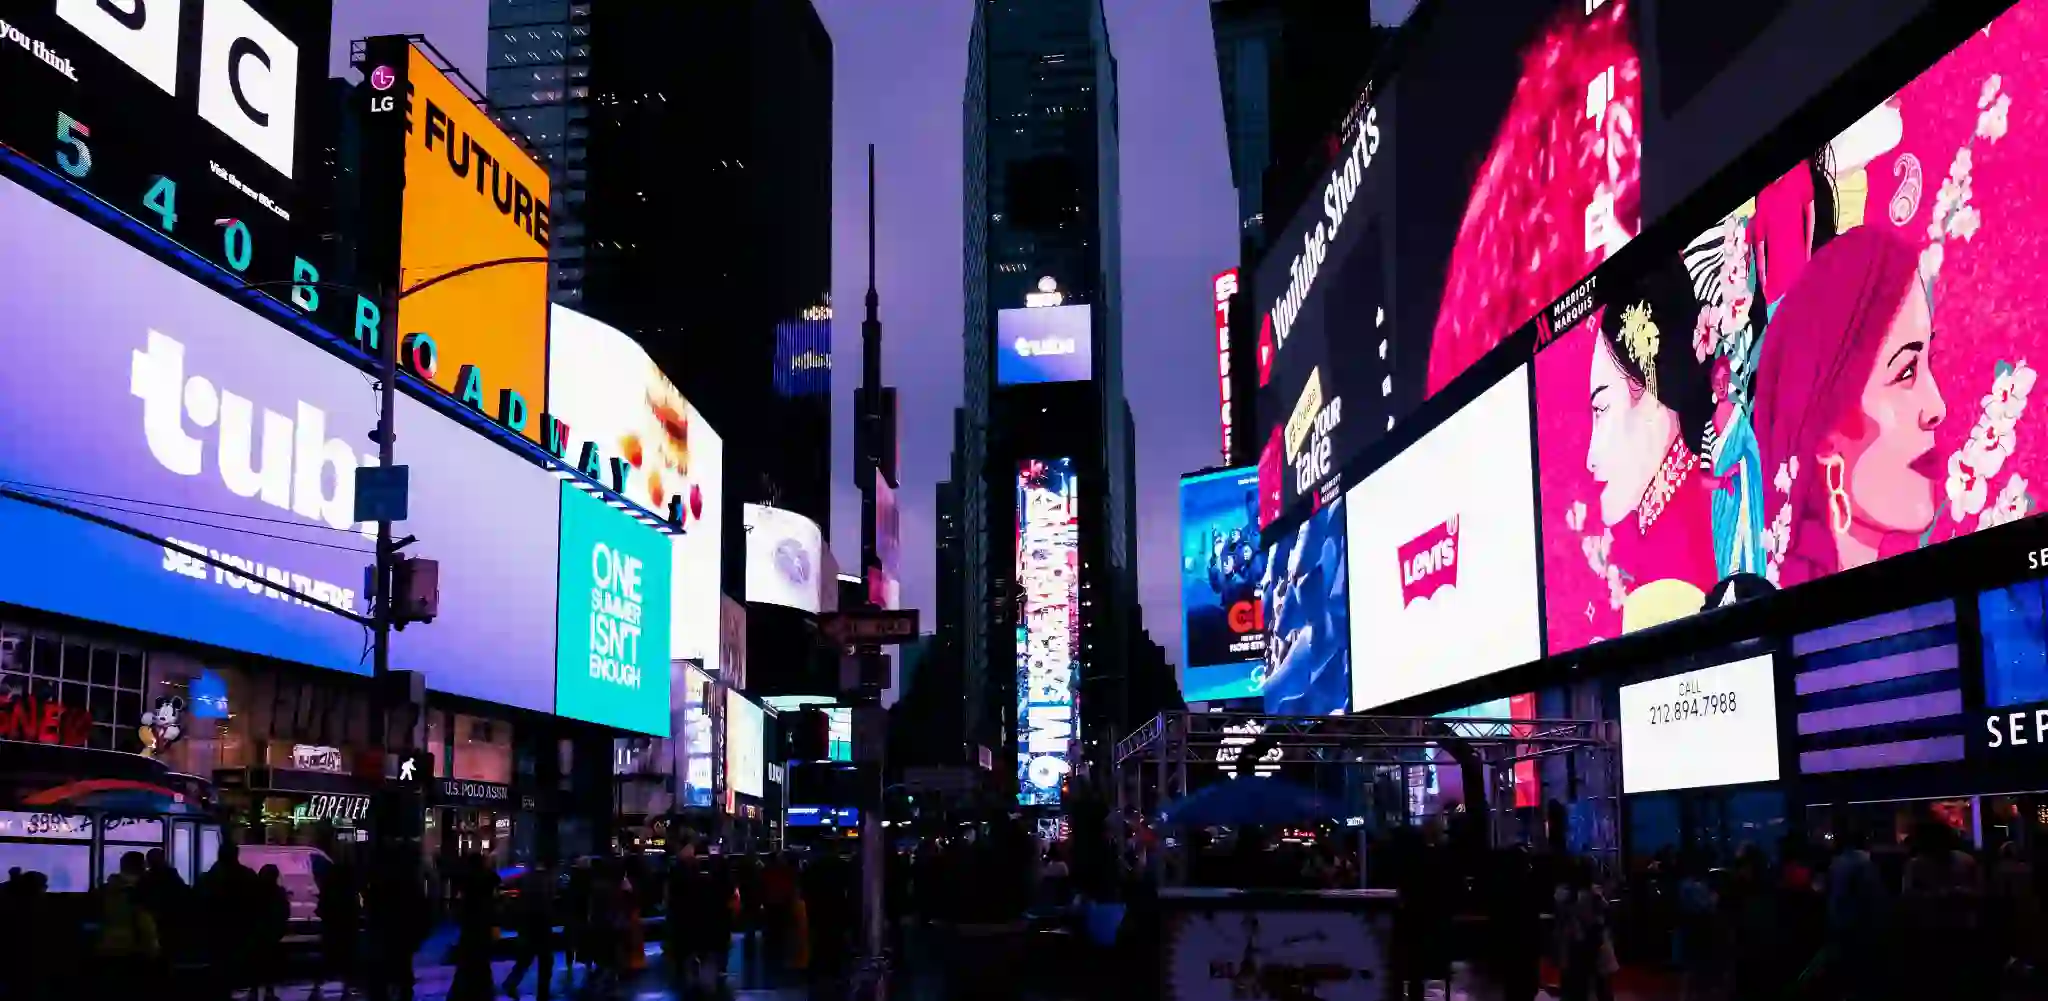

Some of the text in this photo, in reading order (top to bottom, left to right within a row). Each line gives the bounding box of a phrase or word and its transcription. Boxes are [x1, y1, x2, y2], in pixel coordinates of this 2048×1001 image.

[0, 19, 79, 82] you think.
[371, 96, 394, 113] LG
[425, 98, 551, 254] FUTURE
[1271, 106, 1380, 350] YouTube Shorts
[1554, 275, 1597, 317] MARRIOTT
[1554, 296, 1592, 333] MARQUIS
[130, 328, 381, 538] tub
[1314, 395, 1342, 442] YOUR
[1295, 431, 1331, 496] take
[163, 536, 208, 580] SEE
[210, 549, 264, 595] YOU
[592, 542, 643, 603] ONE
[590, 588, 642, 626] SUMMER
[589, 612, 642, 665] ISN'T
[589, 652, 641, 690] ENOUGH
[1679, 680, 1702, 696] CALL
[1650, 691, 1737, 725] 212.894.7988
[307, 794, 370, 820] FOREVER
[444, 781, 460, 797] U.S.
[462, 783, 485, 798] POLO
